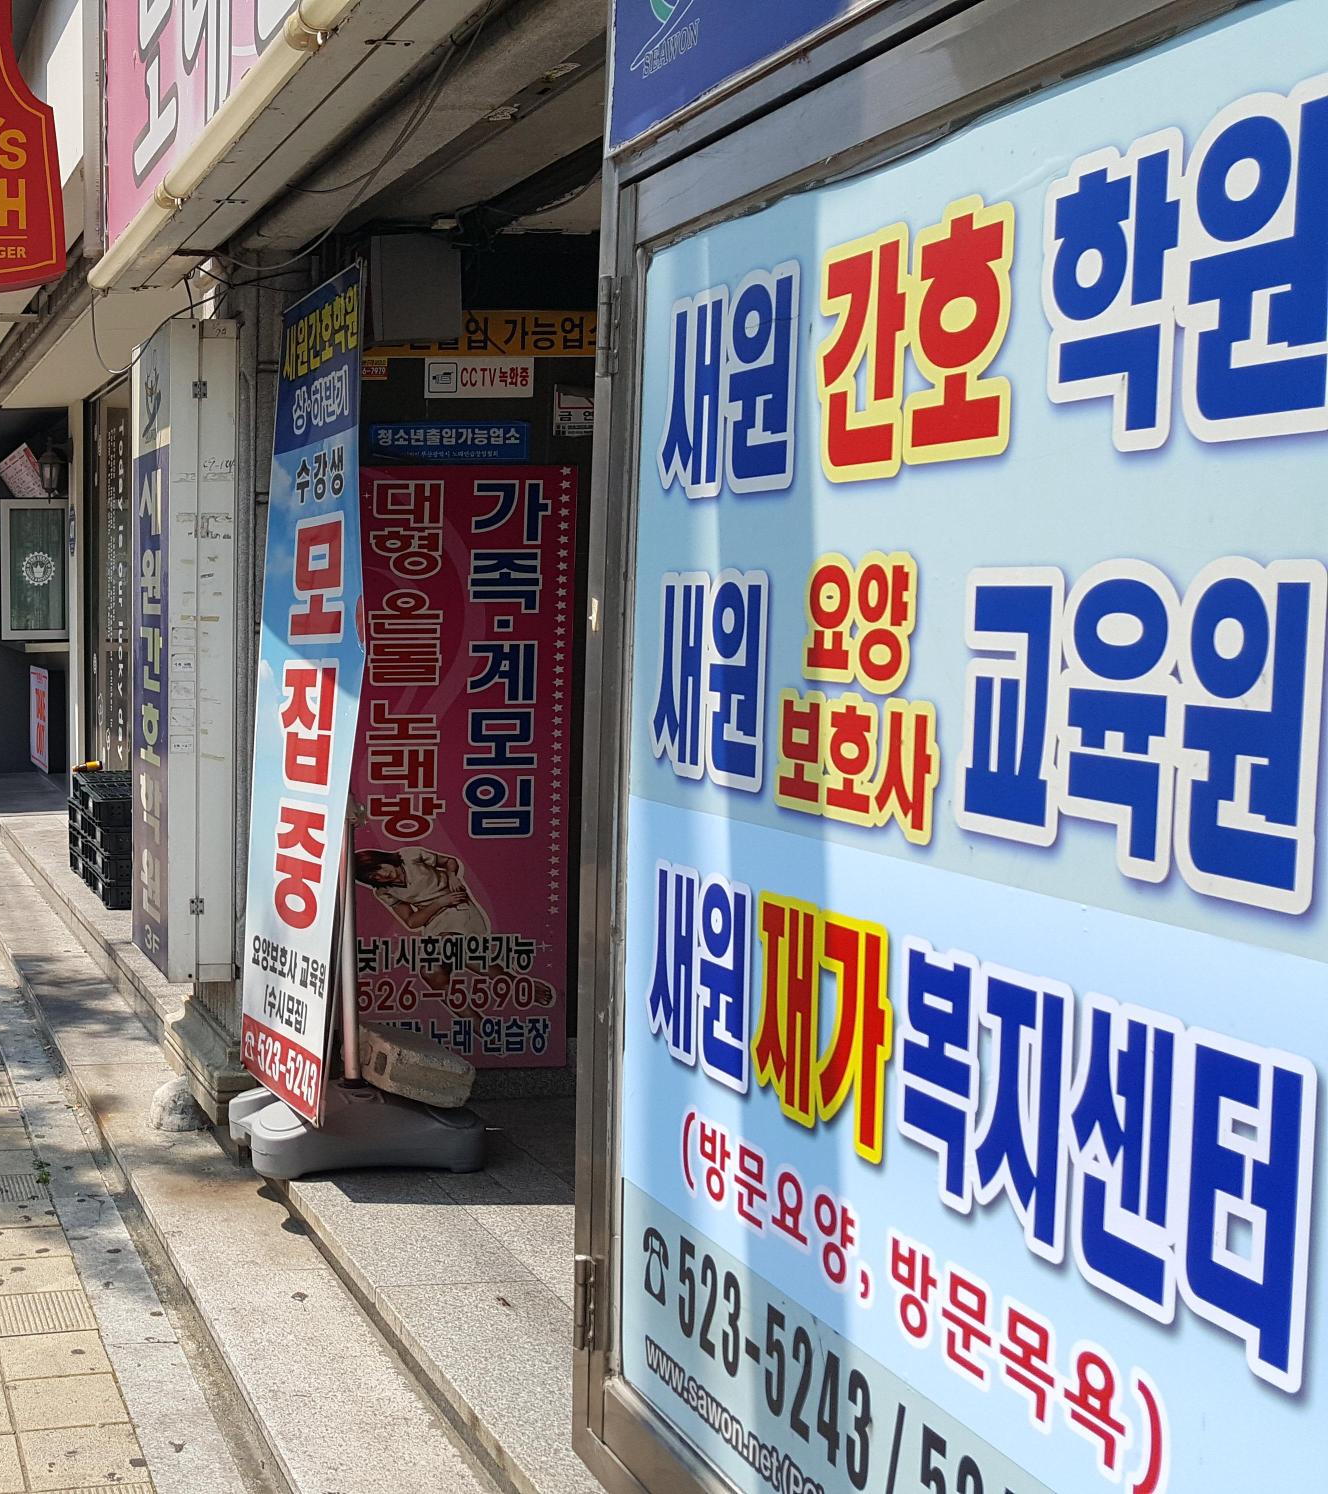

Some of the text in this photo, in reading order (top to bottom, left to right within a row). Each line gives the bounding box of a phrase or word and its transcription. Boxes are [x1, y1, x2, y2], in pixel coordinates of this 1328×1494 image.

[641, 17, 701, 79] SEAWON
[282, 284, 359, 381] 새원간호학원
[660, 97, 1328, 489] 새원 간호 학원
[498, 366, 530, 388] 녹화중
[117, 417, 125, 511] Today
[296, 445, 345, 505] 수강생
[377, 428, 521, 446] 청소년출입가능업소
[369, 479, 446, 580] 대형
[367, 589, 444, 687] 온돌
[806, 562, 911, 682] 요양
[273, 516, 344, 931] 모집중
[652, 581, 764, 779] 새원
[116, 708, 125, 761] day
[366, 699, 447, 841] 노래방
[778, 699, 933, 832] 보호사
[963, 576, 1312, 893] 교육원
[143, 924, 161, 955] 3F
[251, 935, 327, 1000] 요양보호사 교육원
[357, 977, 536, 1014] 526-5590
[482, 1016, 550, 1055] 연습장
[256, 1031, 319, 1107] 523-5243
[648, 867, 1306, 1374] 새원 재가 복지센터
[682, 1110, 1164, 1494] (방문요양, 방문목욕)
[677, 1234, 873, 1492] 523-5243
